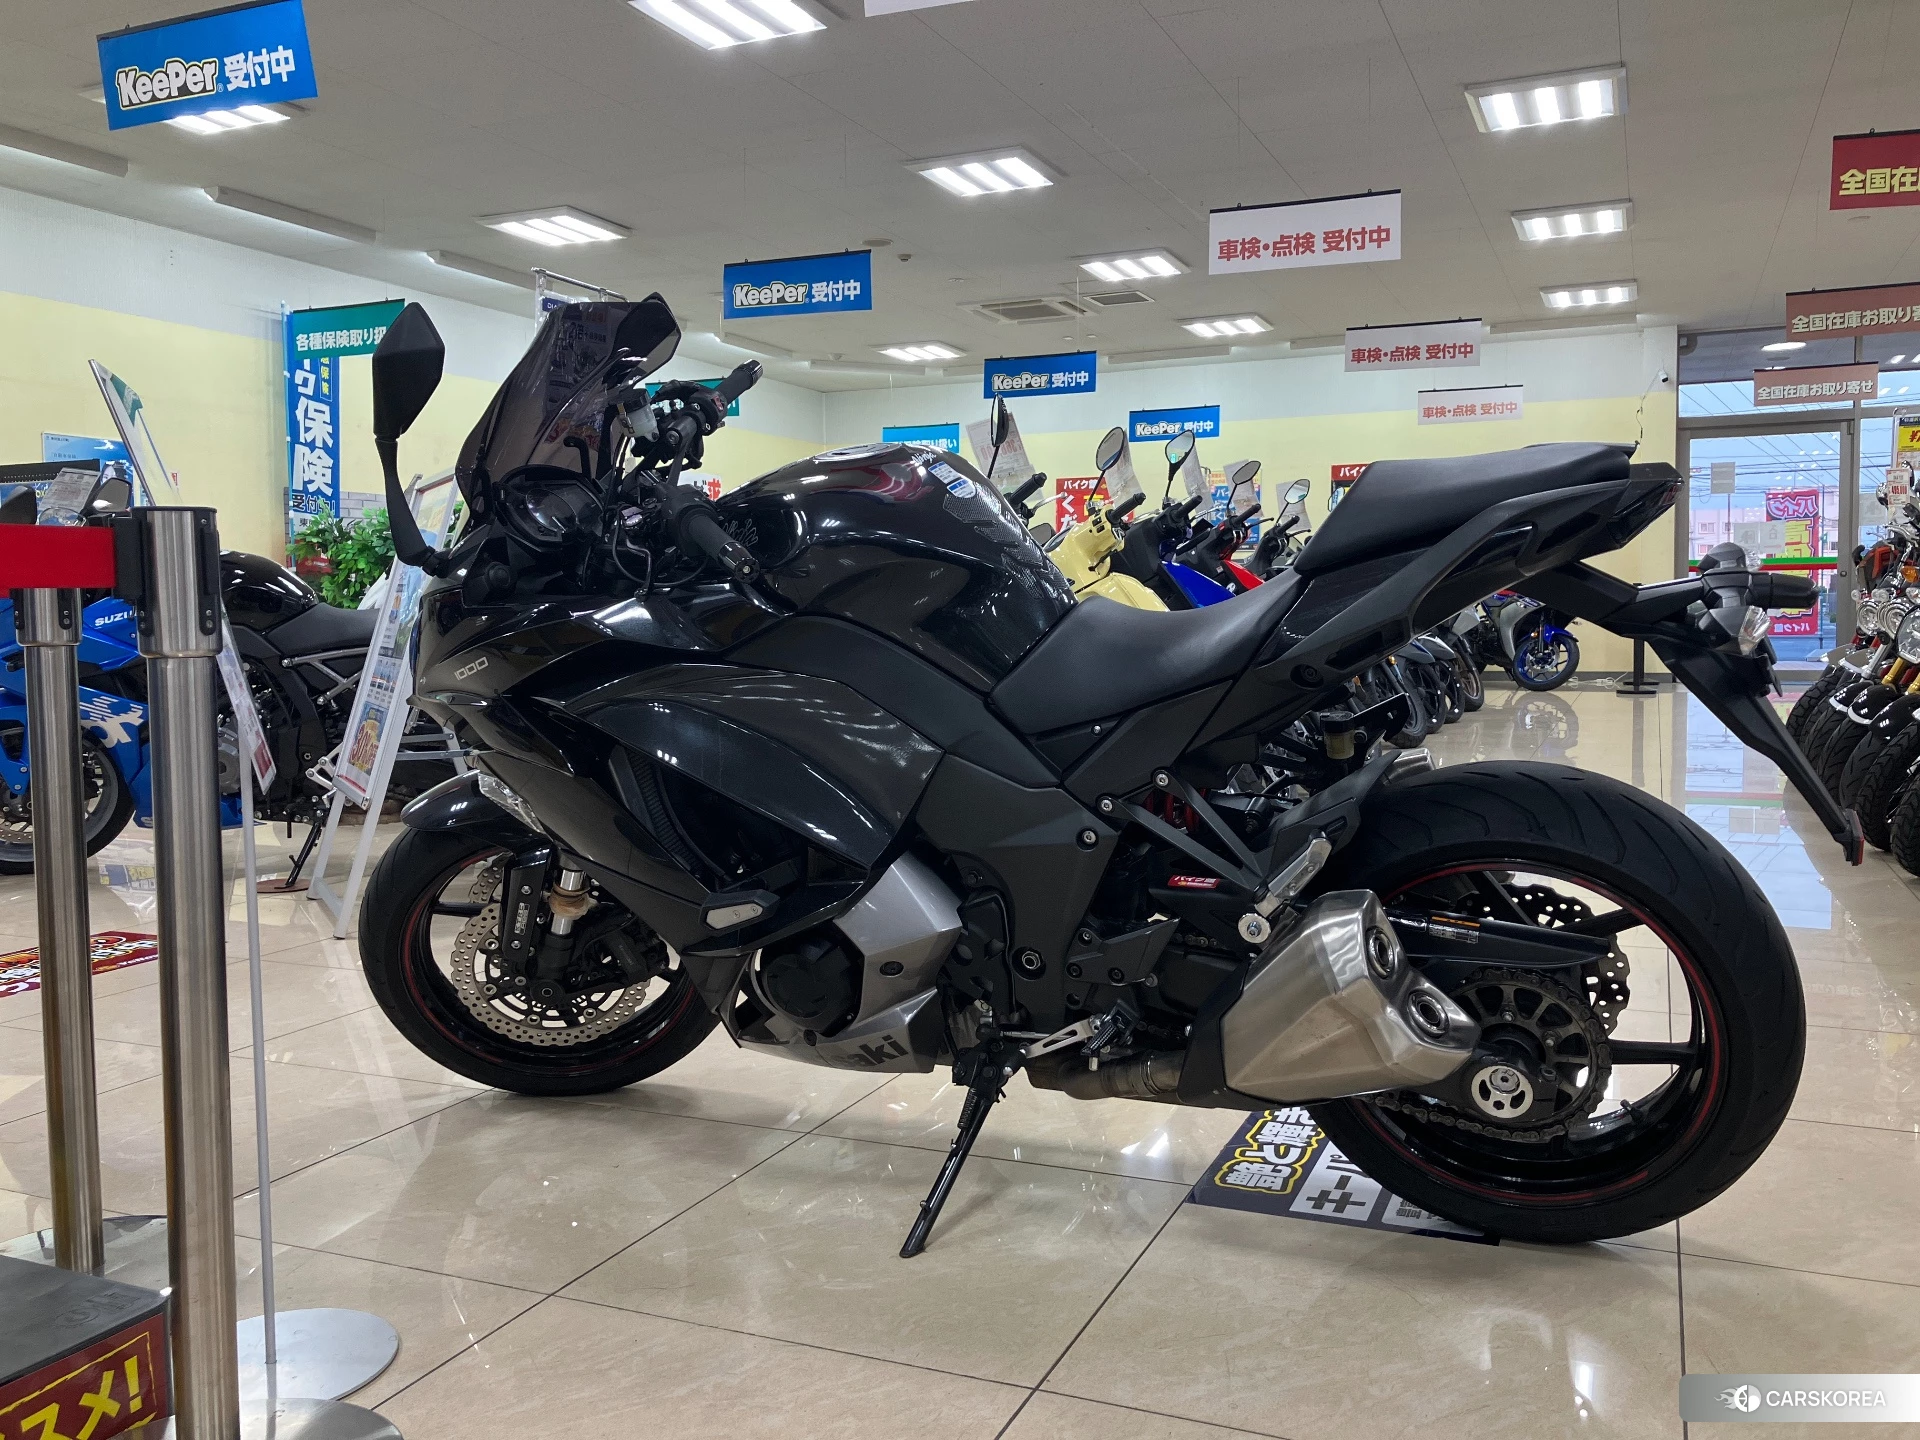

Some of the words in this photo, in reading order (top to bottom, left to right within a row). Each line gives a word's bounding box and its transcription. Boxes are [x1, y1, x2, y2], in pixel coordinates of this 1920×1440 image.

[116, 59, 218, 108] KeePer
[223, 45, 296, 92] 受付中
[1217, 231, 1316, 262] 車検・点検
[1322, 225, 1391, 253] 受付中
[734, 282, 808, 307] KeePer
[811, 279, 861, 304] 受付中
[1350, 344, 1421, 364] 車検・点検
[1425, 342, 1474, 361] 受付中
[992, 372, 1050, 391] KeePer
[1051, 370, 1089, 388] 受付中
[1757, 379, 1875, 401] 全国在庫お取り寄せ
[1422, 403, 1477, 419] 車検・点検
[1480, 401, 1518, 415] 受付中
[1135, 421, 1181, 436] KeePer
[1183, 420, 1214, 433] 受付中
[454, 656, 489, 681] 1000
